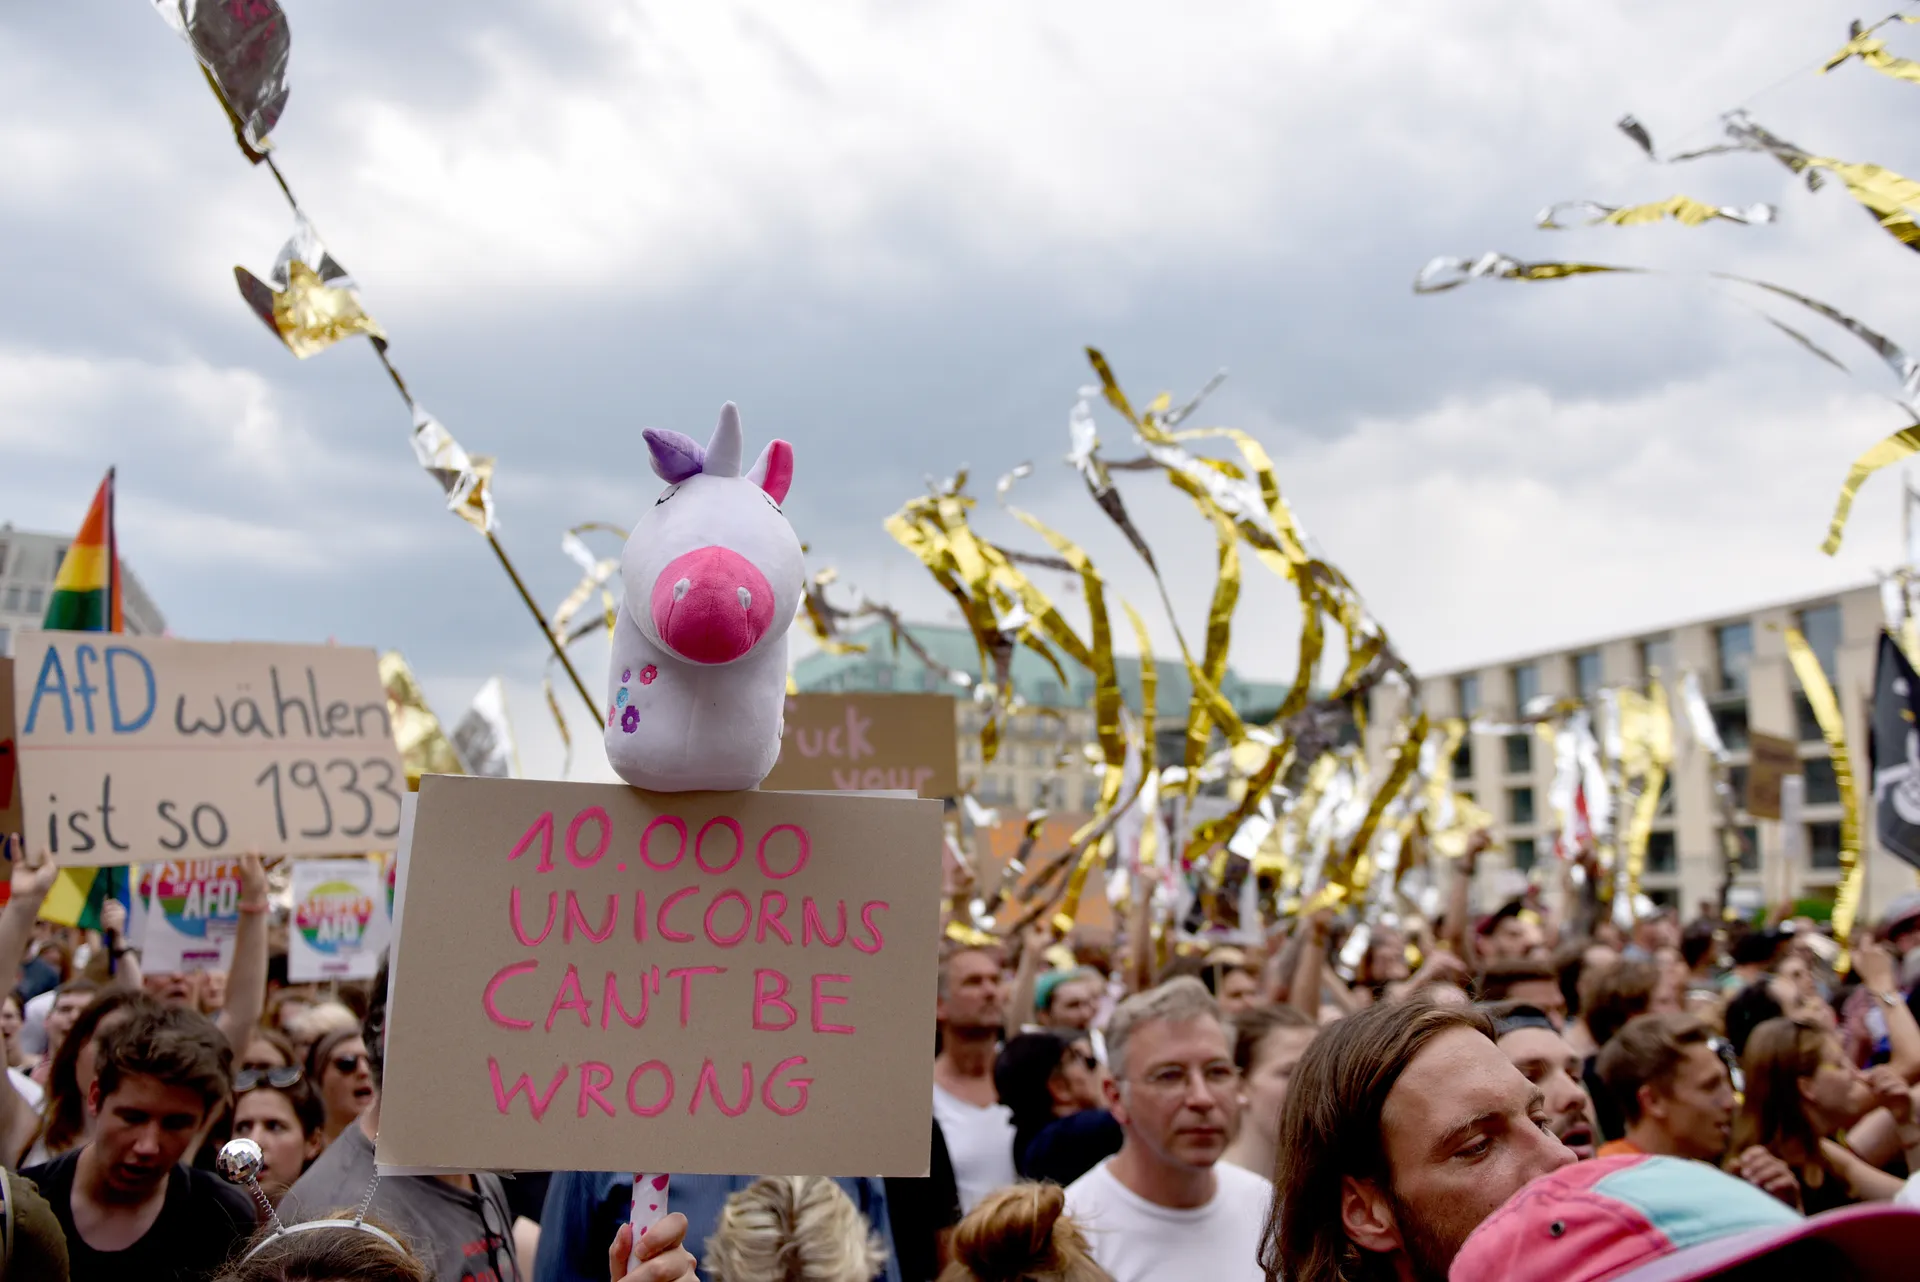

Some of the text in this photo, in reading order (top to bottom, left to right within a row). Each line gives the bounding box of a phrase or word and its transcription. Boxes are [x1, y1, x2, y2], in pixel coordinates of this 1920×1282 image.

[23, 644, 391, 739] AfD wählen
[784, 701, 876, 762] uck
[48, 773, 129, 854] ist
[157, 800, 229, 851] so
[255, 758, 401, 843] 1933
[507, 805, 812, 880] 10.000
[509, 886, 890, 954] UNICORNS
[482, 959, 857, 1034] CAN'T BE
[487, 1055, 815, 1121] WRONG
